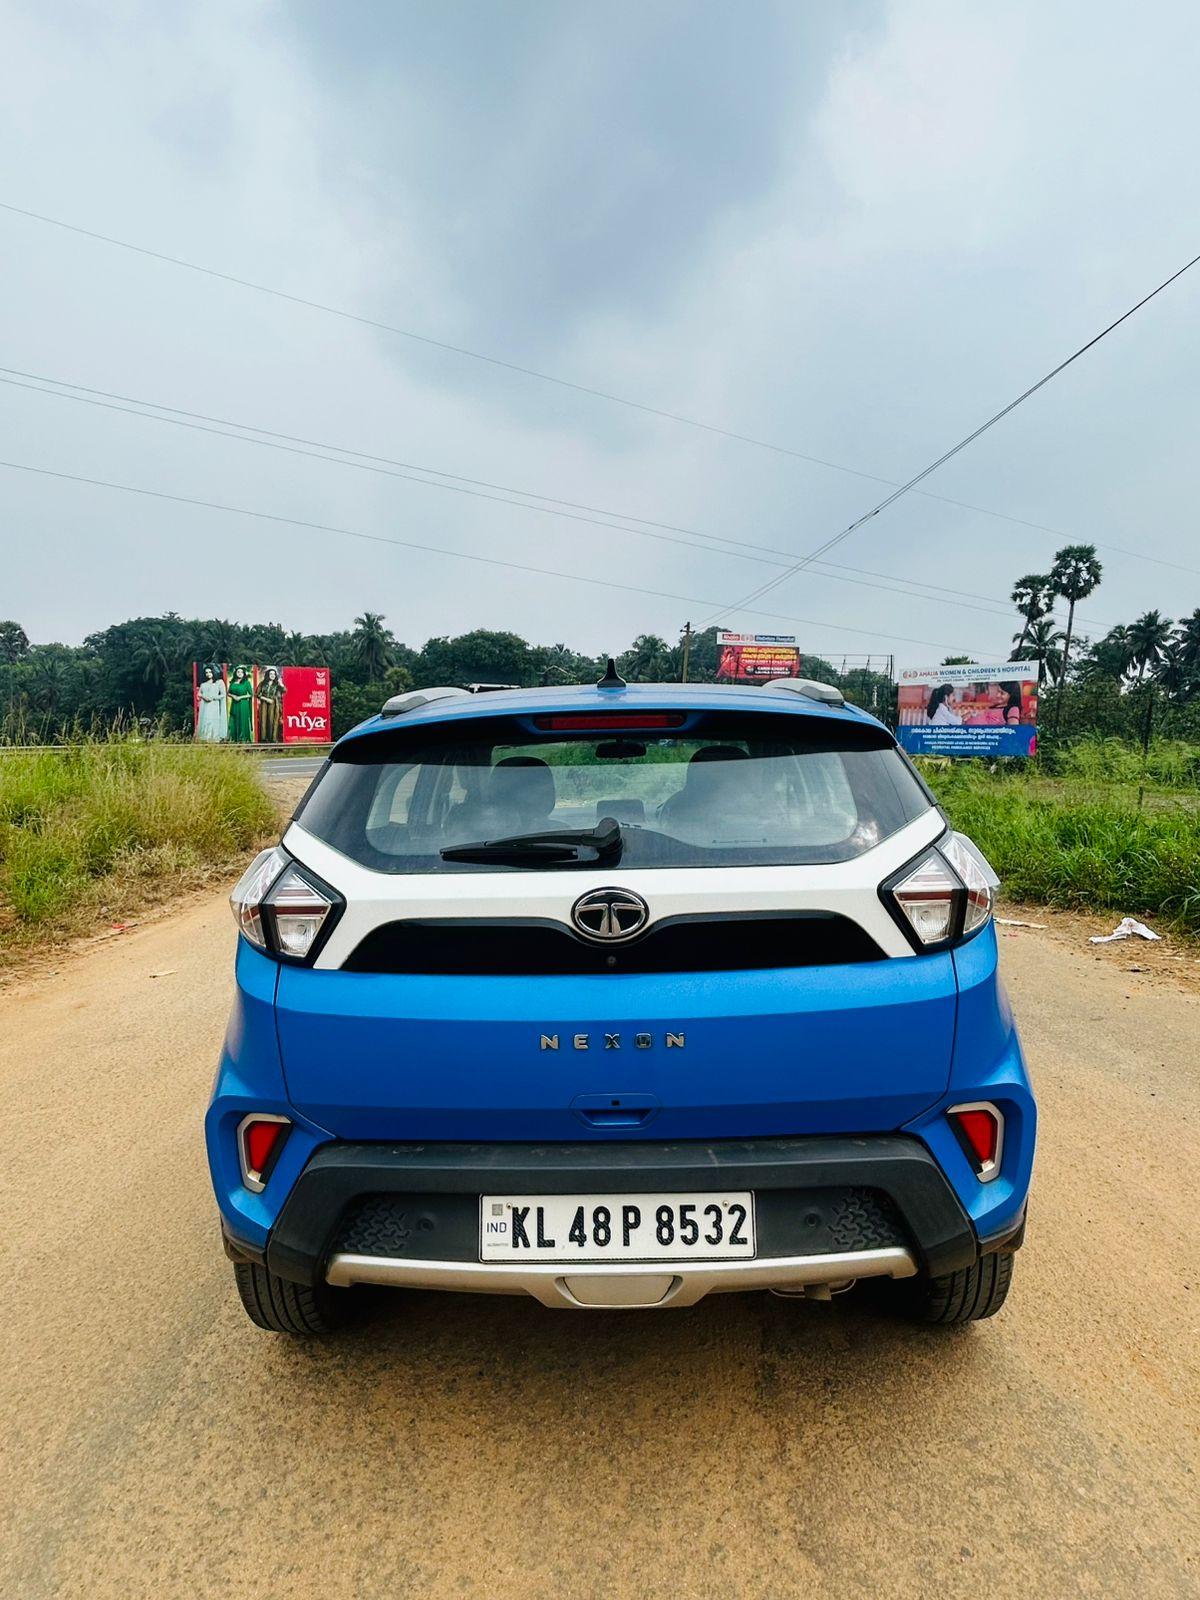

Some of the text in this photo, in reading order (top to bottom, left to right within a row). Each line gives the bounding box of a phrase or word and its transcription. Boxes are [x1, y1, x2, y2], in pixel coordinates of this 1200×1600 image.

[939, 668, 962, 676] WOMEN
[1001, 665, 1031, 673] HOSPITAL
[287, 711, 327, 732] niya
[540, 1032, 685, 1051] NEXON
[486, 1222, 507, 1233] IND
[511, 1203, 748, 1249] KL 48 P 8532
